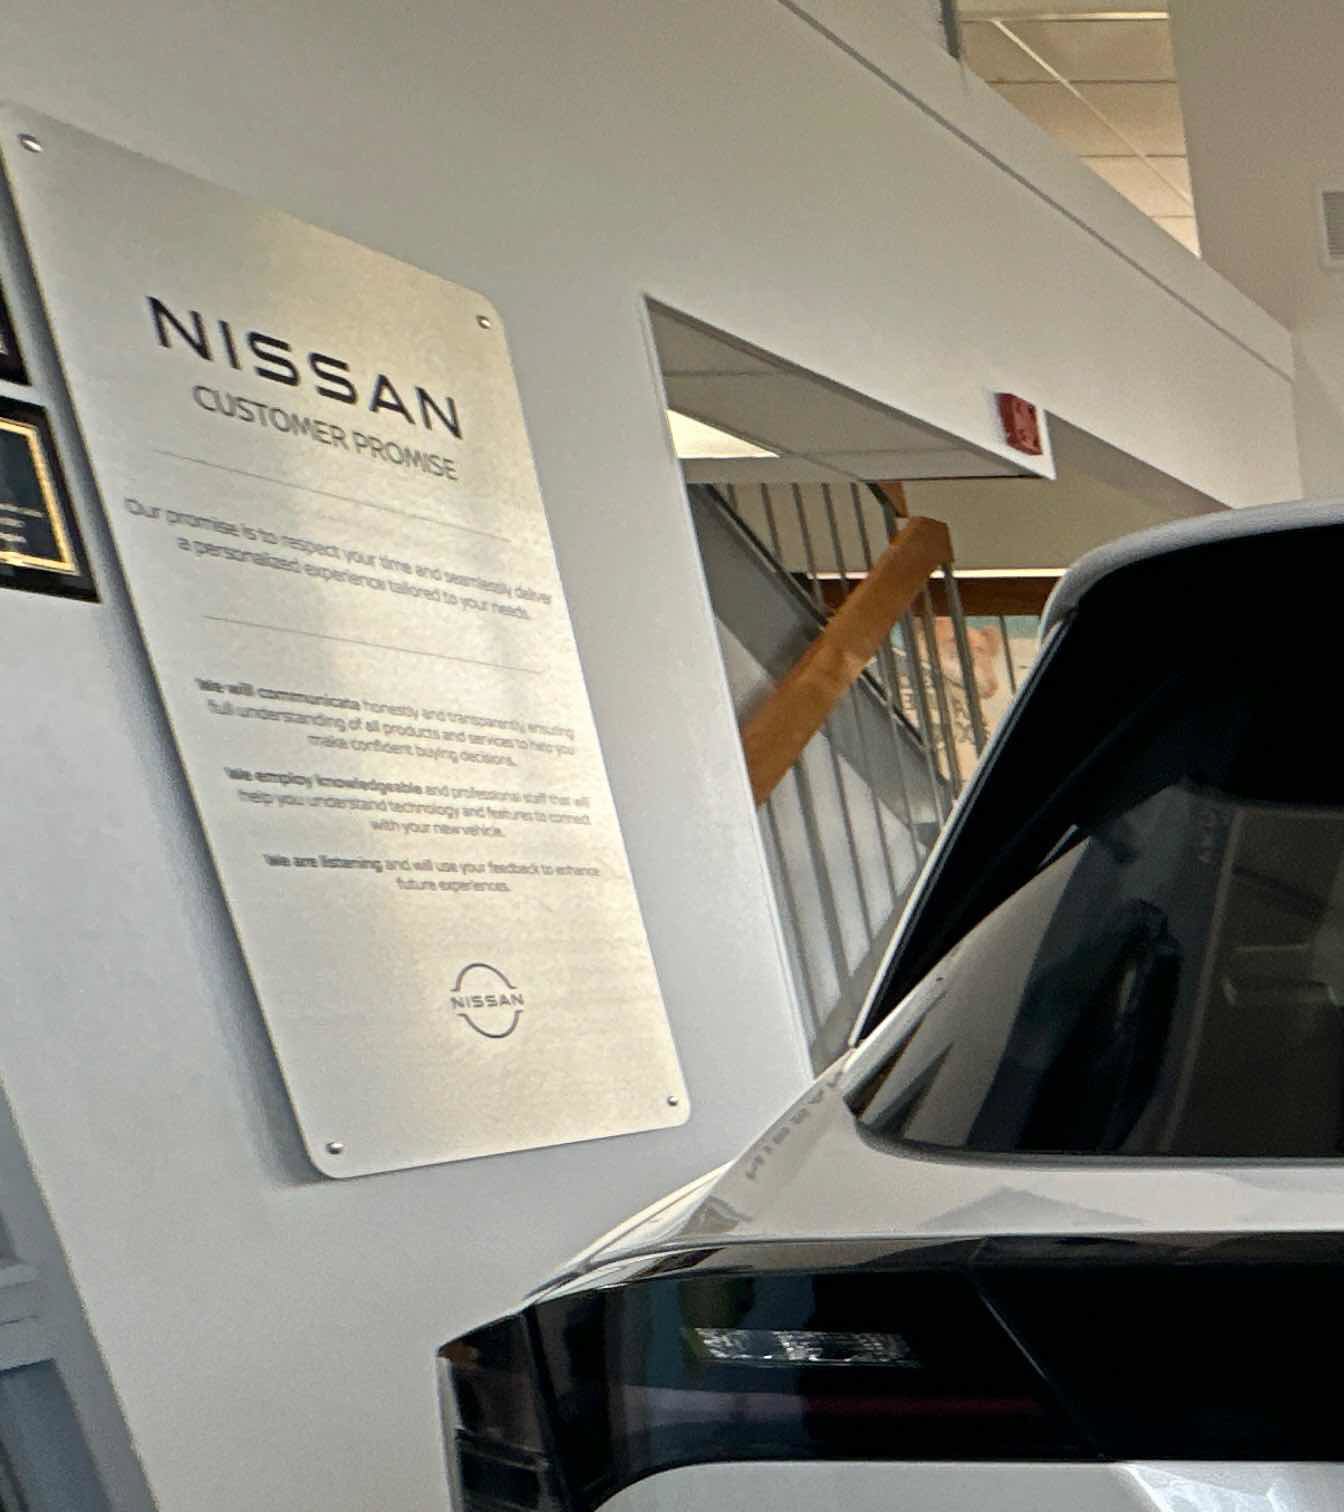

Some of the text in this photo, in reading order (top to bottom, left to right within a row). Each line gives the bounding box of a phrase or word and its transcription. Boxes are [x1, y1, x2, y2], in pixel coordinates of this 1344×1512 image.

[147, 295, 463, 440] NISSAN
[192, 384, 459, 481] CUSTOMER PROMISE
[450, 993, 524, 1009] NISSAN
